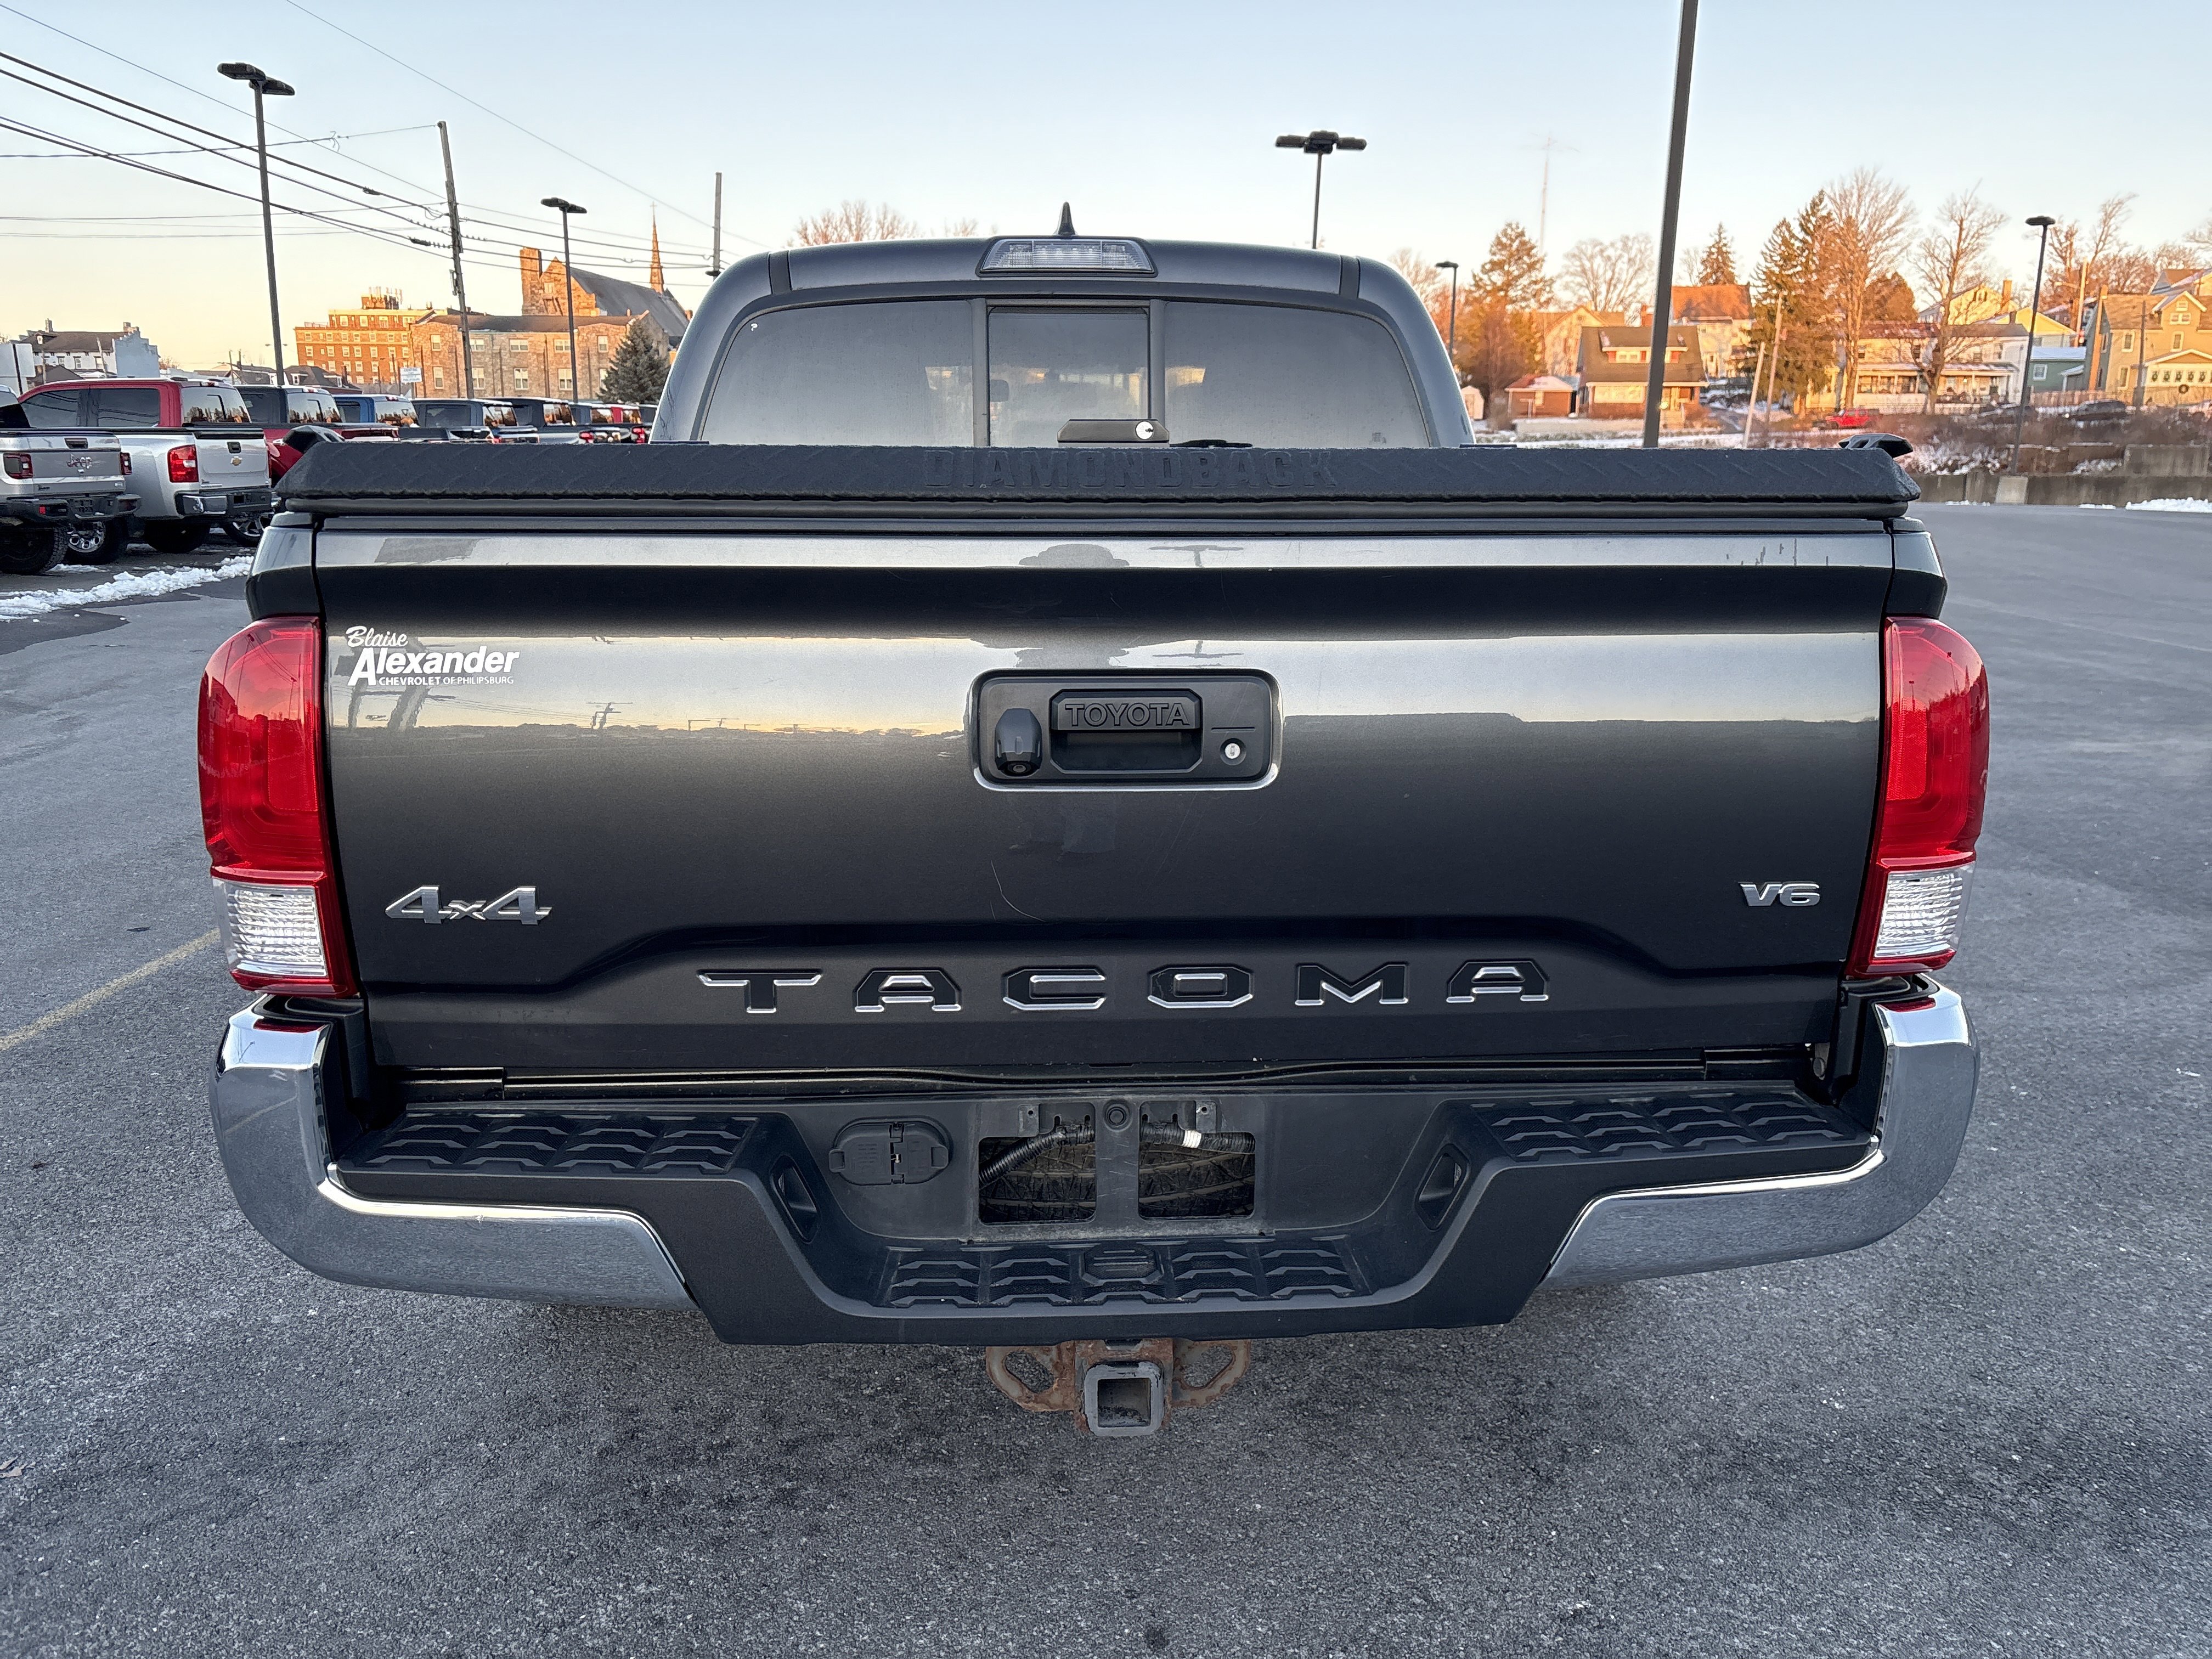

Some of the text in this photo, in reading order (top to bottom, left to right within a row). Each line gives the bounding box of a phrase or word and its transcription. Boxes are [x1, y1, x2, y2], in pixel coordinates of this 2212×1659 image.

[924, 450, 1337, 488] DIAMONDBACK
[346, 625, 408, 647] Blaise
[347, 646, 520, 686] Alexander
[379, 676, 440, 686] CHEVROLET
[457, 676, 514, 684] PHILIPSBURG
[1065, 703, 1190, 726] TOYOTA
[385, 885, 552, 925] 4x4
[1738, 881, 1821, 907] V6
[696, 958, 1549, 1014] TACOMA
